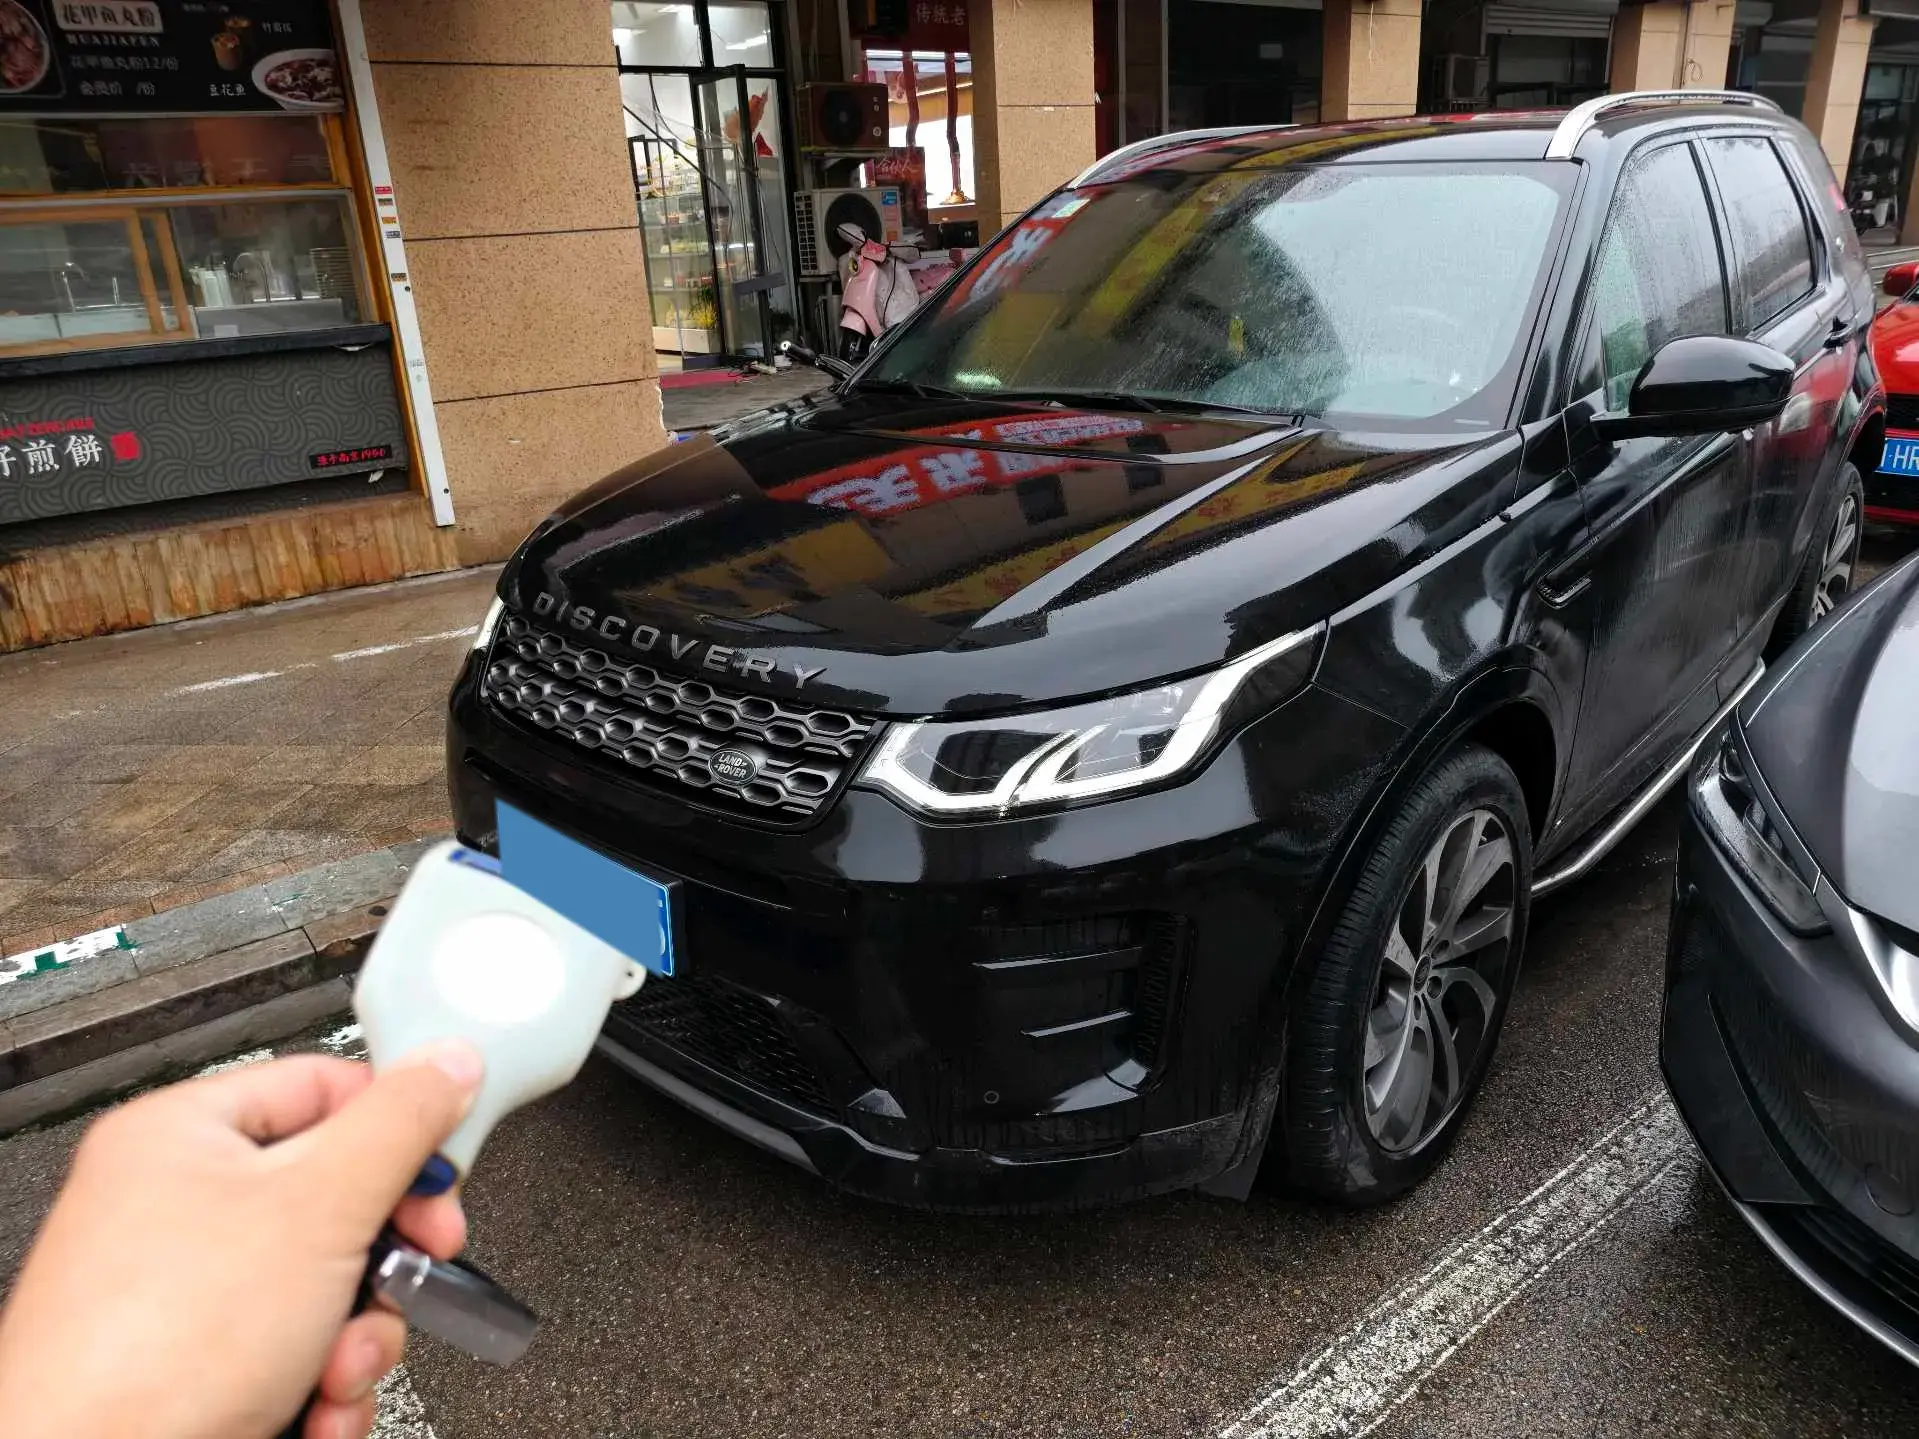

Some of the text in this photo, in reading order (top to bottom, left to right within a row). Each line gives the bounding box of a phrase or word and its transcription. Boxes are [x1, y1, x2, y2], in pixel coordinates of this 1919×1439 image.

[915, 3, 967, 26] 传统老
[532, 591, 827, 690] DISCOVERY
[718, 753, 745, 767] LAND
[717, 764, 747, 778] ROVER
